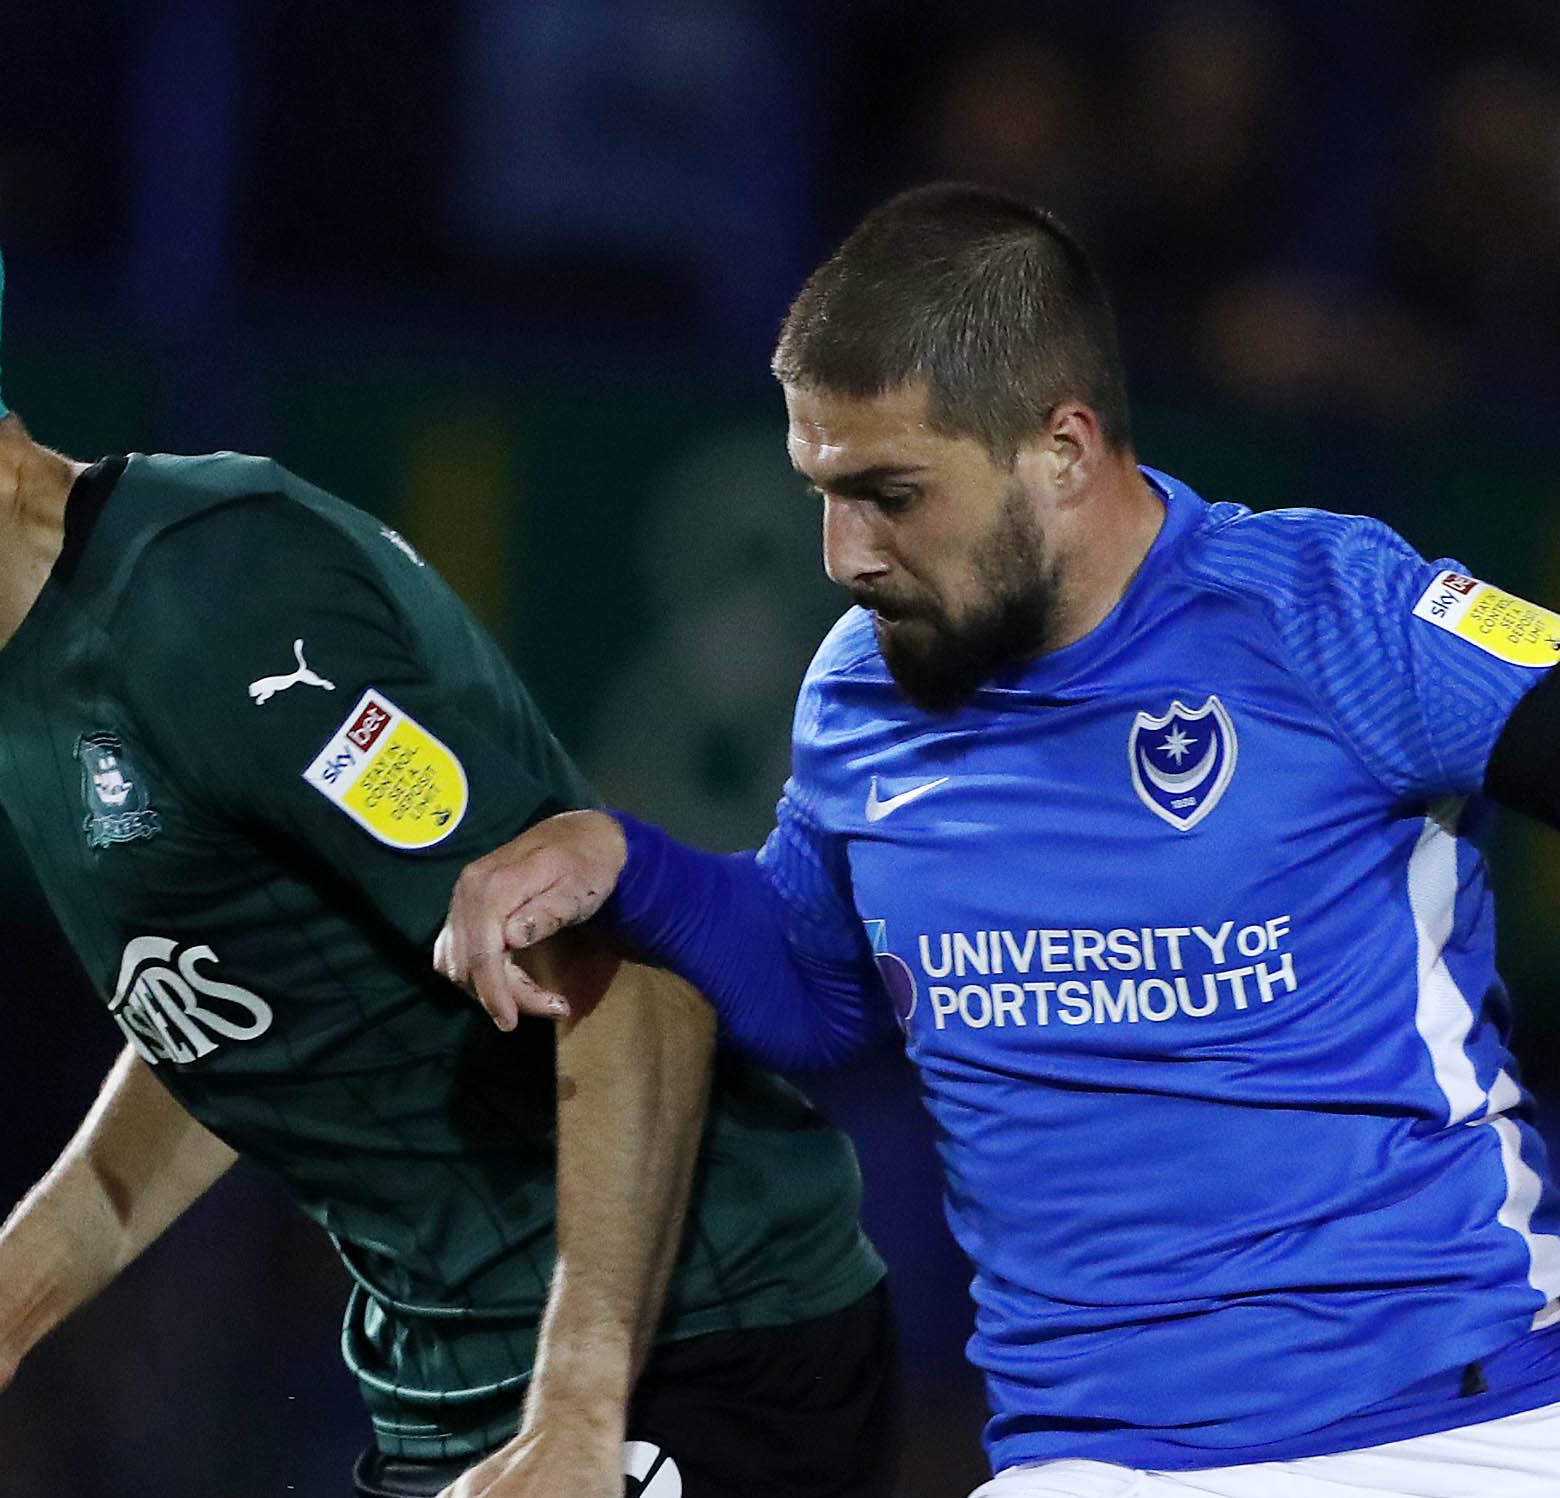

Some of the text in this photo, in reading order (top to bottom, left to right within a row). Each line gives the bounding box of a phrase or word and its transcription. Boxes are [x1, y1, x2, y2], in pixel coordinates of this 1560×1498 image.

[1432, 590, 1460, 617] sky
[323, 707, 386, 784] sky bet
[919, 915, 1292, 978] UNIVERSITY OF
[928, 952, 1298, 1030] PORTSMOUTH
